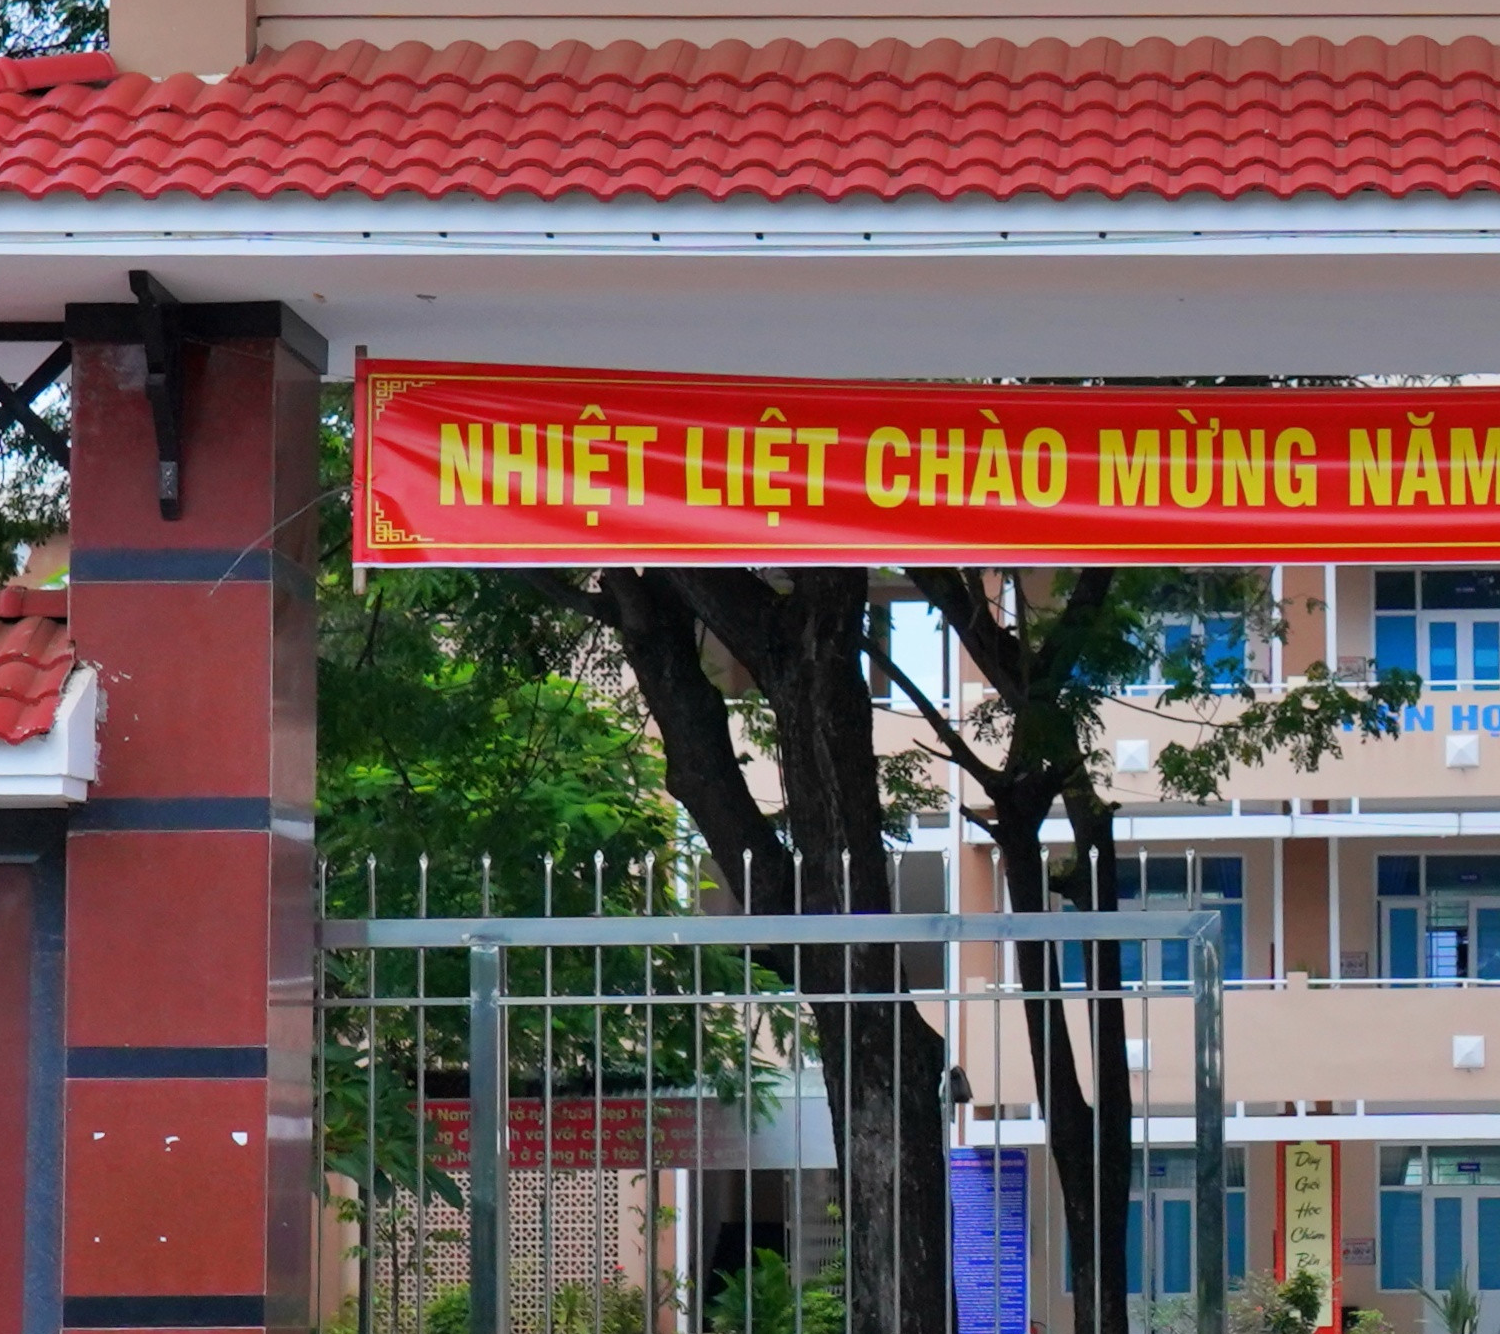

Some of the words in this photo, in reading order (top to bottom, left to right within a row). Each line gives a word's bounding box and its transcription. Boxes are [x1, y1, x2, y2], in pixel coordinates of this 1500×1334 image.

[437, 403, 659, 528] NHIỆT
[686, 406, 841, 528] LIỆT
[864, 408, 1068, 509] CHÀO
[1099, 408, 1319, 510] MỪNG
